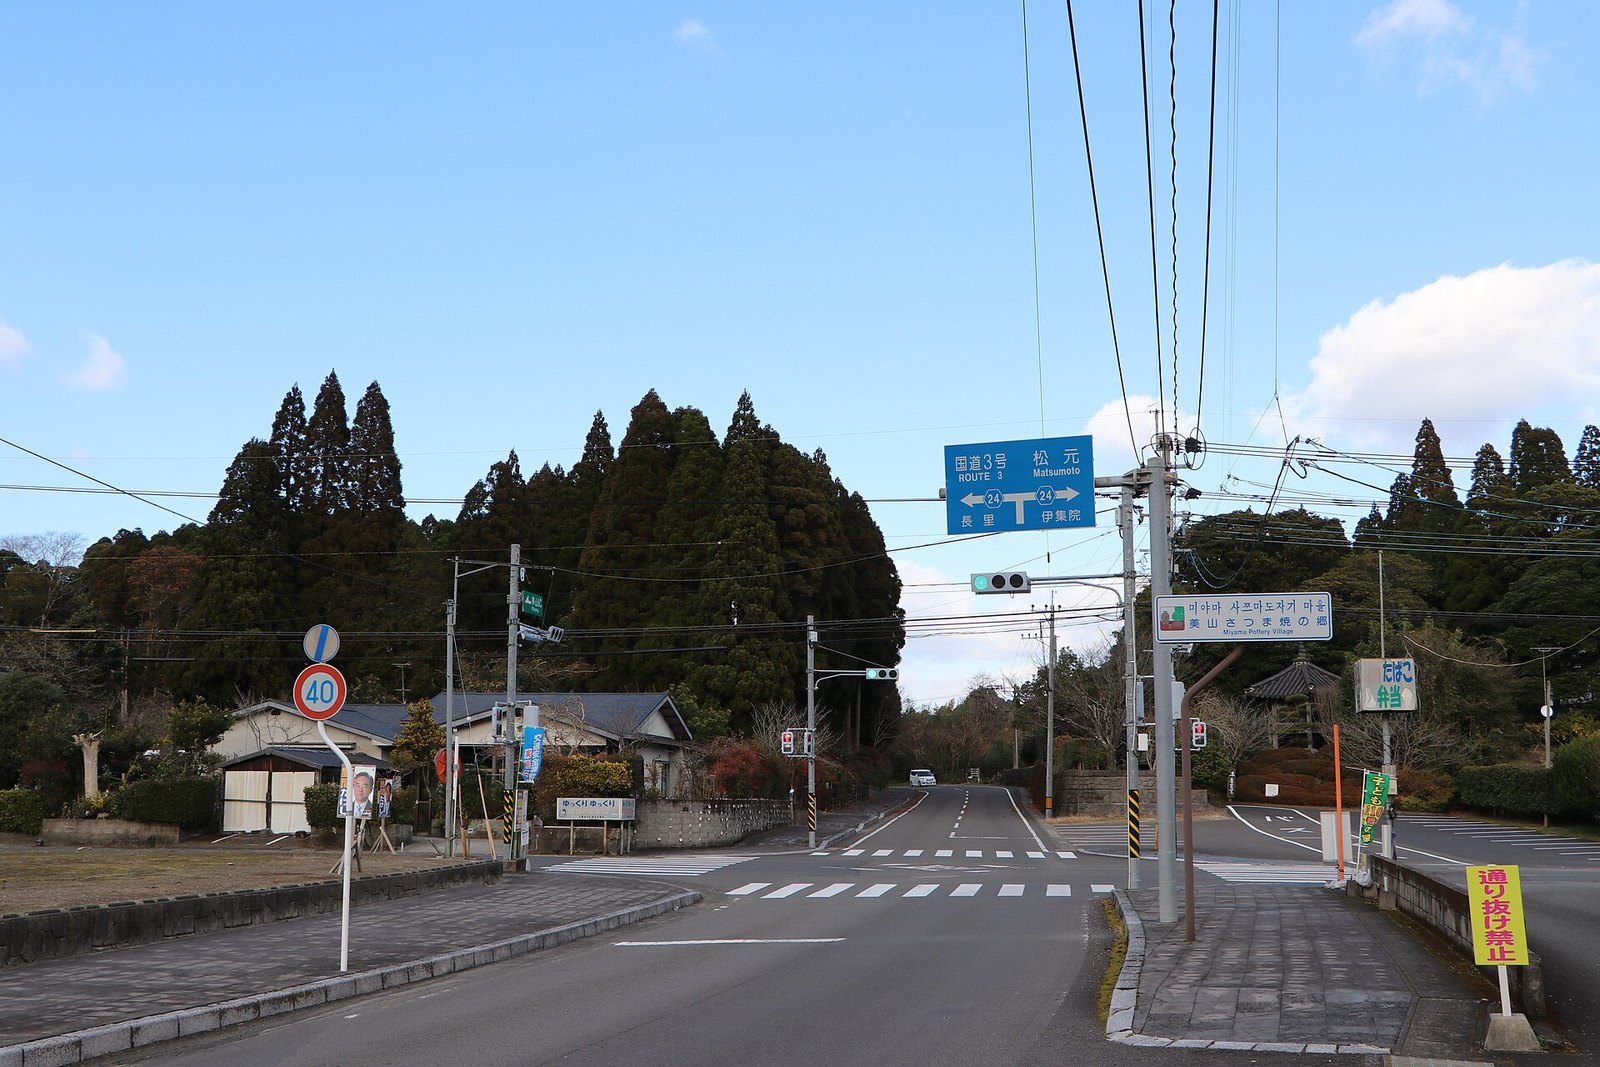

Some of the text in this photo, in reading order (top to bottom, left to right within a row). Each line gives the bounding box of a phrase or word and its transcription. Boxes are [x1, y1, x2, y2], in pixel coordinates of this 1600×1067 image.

[955, 453, 1006, 471] 国道3号
[1033, 448, 1079, 466] 松元
[958, 470, 1003, 482] ROUTE 3
[1033, 466, 1081, 478] Matsumoto
[987, 493, 1000, 505] 24
[1039, 490, 1052, 501] 24
[961, 514, 994, 527] 長里
[1041, 509, 1081, 524] 伊集院
[1188, 601, 1222, 616] 미야마
[1189, 616, 1327, 628] 美山さつま焼の郷
[1248, 629, 1271, 637] Pottery
[1272, 628, 1294, 636] Village
[1383, 661, 1413, 683] たばこ
[305, 679, 335, 704] 40
[1377, 684, 1402, 709] 弁当
[1478, 869, 1517, 962] 通り抜け禁止
